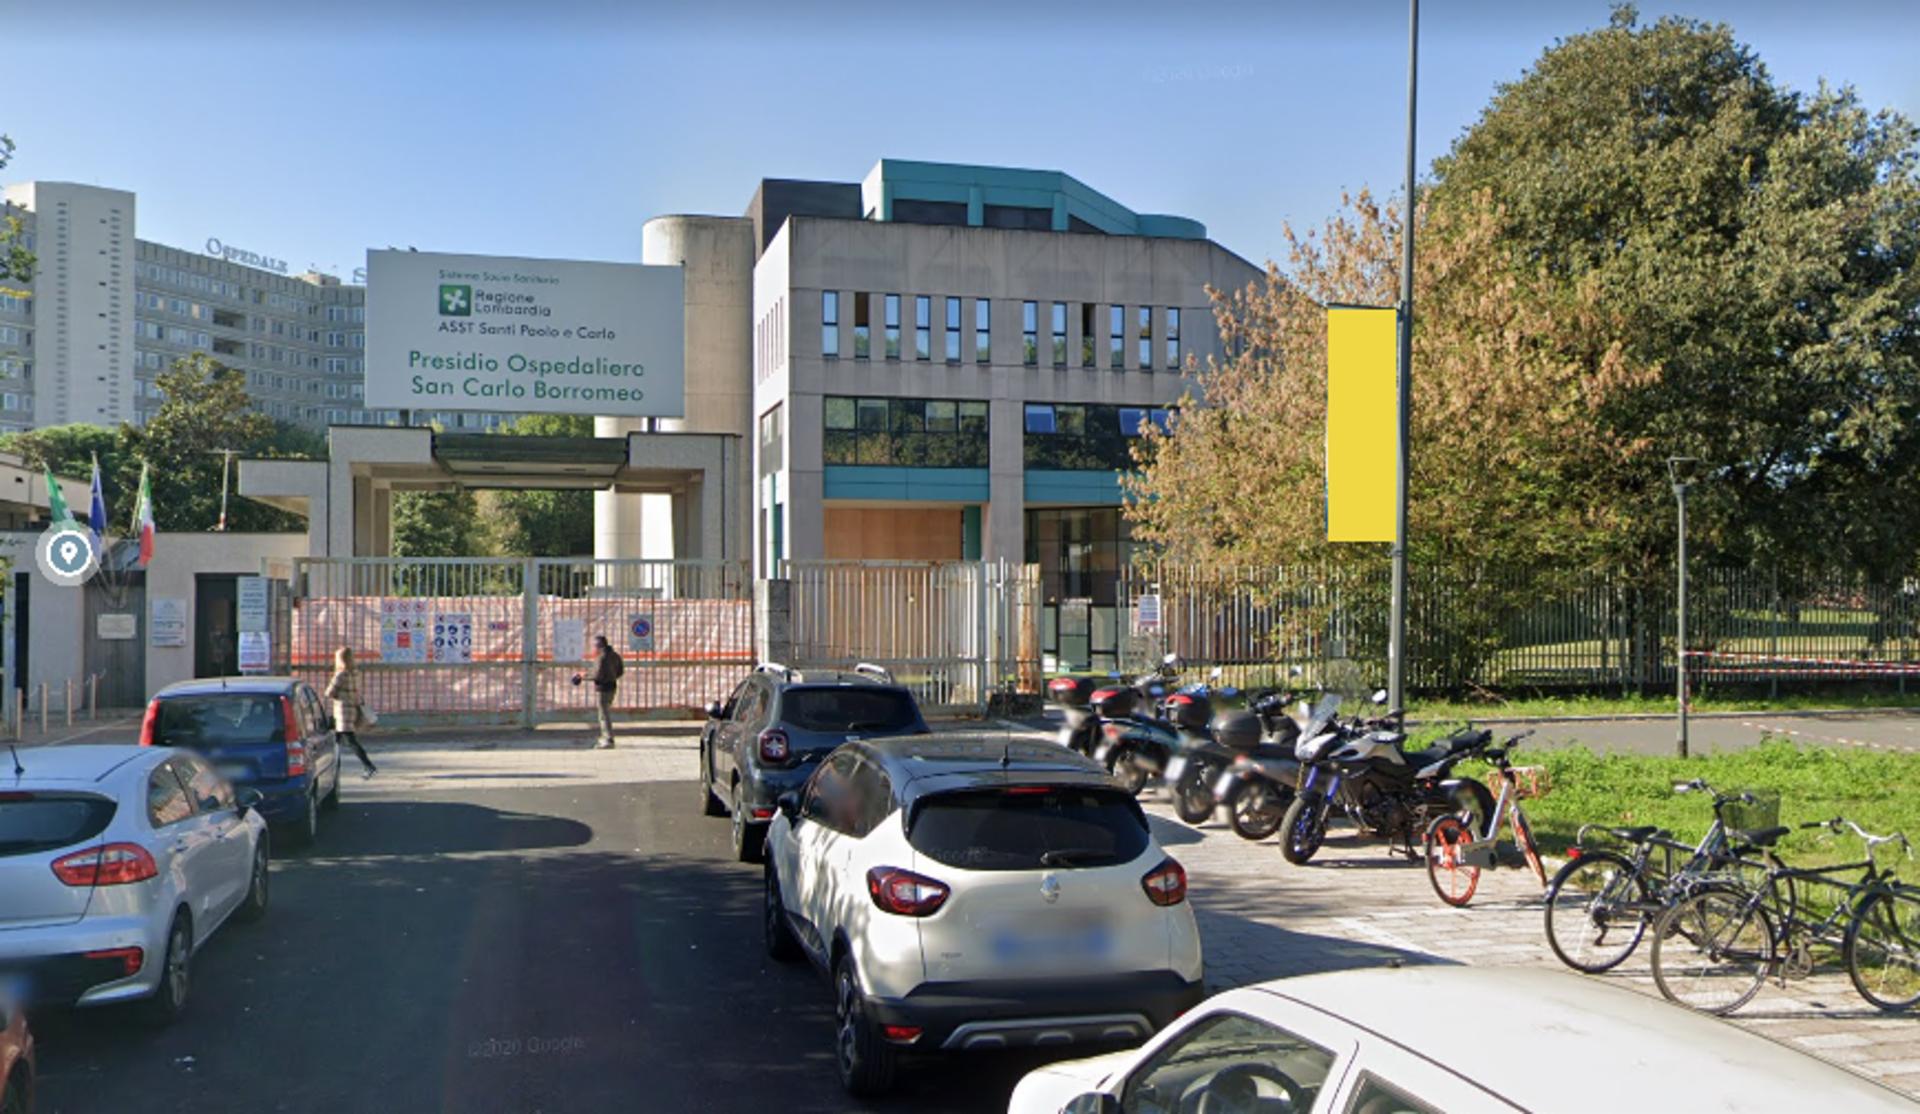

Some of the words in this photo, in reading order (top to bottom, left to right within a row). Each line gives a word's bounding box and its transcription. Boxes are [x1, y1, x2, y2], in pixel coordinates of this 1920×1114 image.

[475, 288, 535, 304] Regione
[475, 303, 551, 317] Lombardia
[438, 320, 475, 334] ASST
[479, 322, 516, 336] Santi
[521, 324, 559, 338] Paolo
[563, 328, 573, 338] e
[577, 326, 616, 340] Carlo
[409, 350, 499, 372] Presidio
[507, 354, 645, 377] Ospedaliero
[412, 375, 454, 395] San
[463, 377, 525, 398] Carlo
[534, 380, 644, 401] Borromeo
